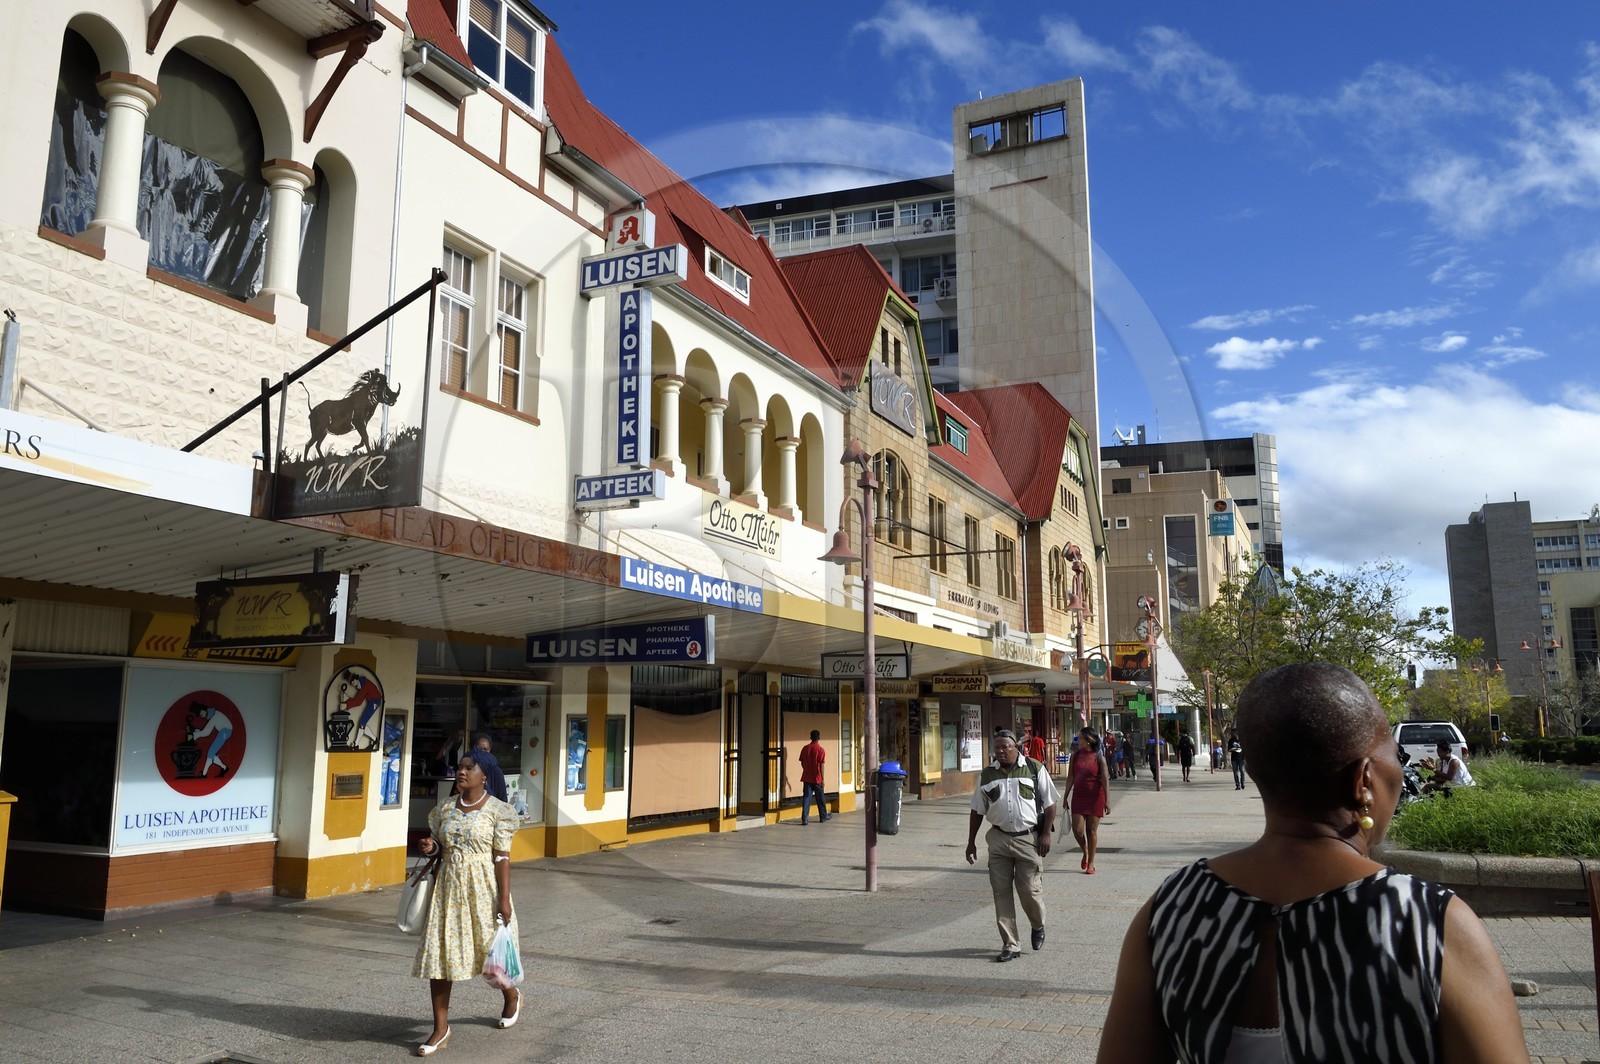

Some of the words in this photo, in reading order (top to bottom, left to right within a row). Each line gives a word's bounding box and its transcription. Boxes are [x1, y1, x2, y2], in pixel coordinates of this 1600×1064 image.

[583, 248, 675, 288] LUISEN
[622, 294, 638, 461] APOTHEKE
[0, 427, 42, 460] RS
[304, 454, 389, 494] NWR
[577, 474, 653, 499] APTEEK
[380, 506, 456, 549] HEAD
[469, 525, 547, 568] OFFICE
[710, 499, 738, 533] Otto
[740, 512, 781, 550] Mühr
[625, 557, 676, 594] Luisen
[690, 573, 762, 608] Apotheke
[236, 589, 293, 617] NWR
[646, 625, 691, 634] APOTHEKE
[646, 635, 692, 644] PHARMACY
[532, 637, 638, 659] LUISEN
[646, 648, 679, 656] APTEEK
[832, 659, 856, 674] Otto
[124, 810, 185, 830] LUISEN
[187, 804, 269, 825] APOTHEKE
[145, 831, 157, 840] 181
[162, 826, 219, 839] INDEPENDENCE
[222, 824, 250, 833] AVENUE
